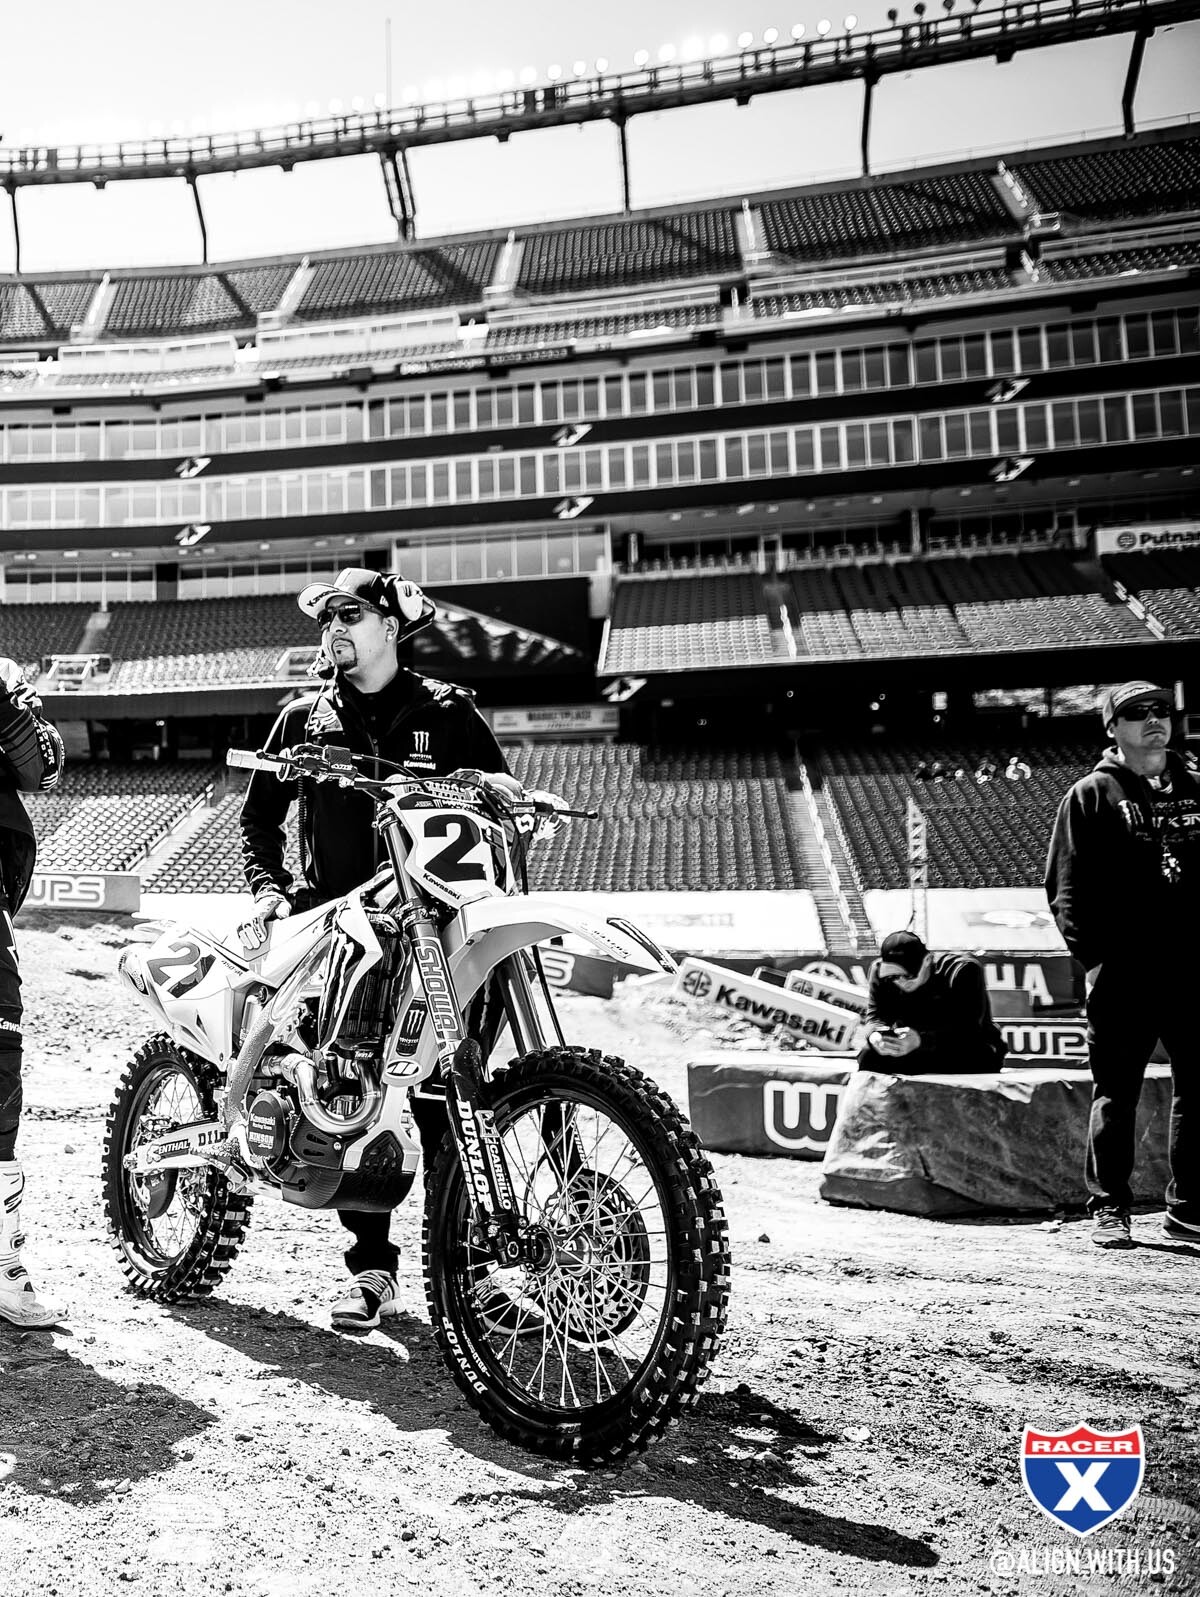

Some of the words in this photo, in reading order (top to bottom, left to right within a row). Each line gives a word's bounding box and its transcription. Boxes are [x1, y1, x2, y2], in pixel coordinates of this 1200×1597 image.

[422, 872, 461, 900] Kawasaki
[415, 945, 459, 1032] SHOWA
[715, 984, 847, 1045] Kawasaki
[456, 1099, 495, 1215] DUNLOP
[489, 1142, 512, 1210] CARRILLO
[442, 1316, 489, 1395] DUNLOP
